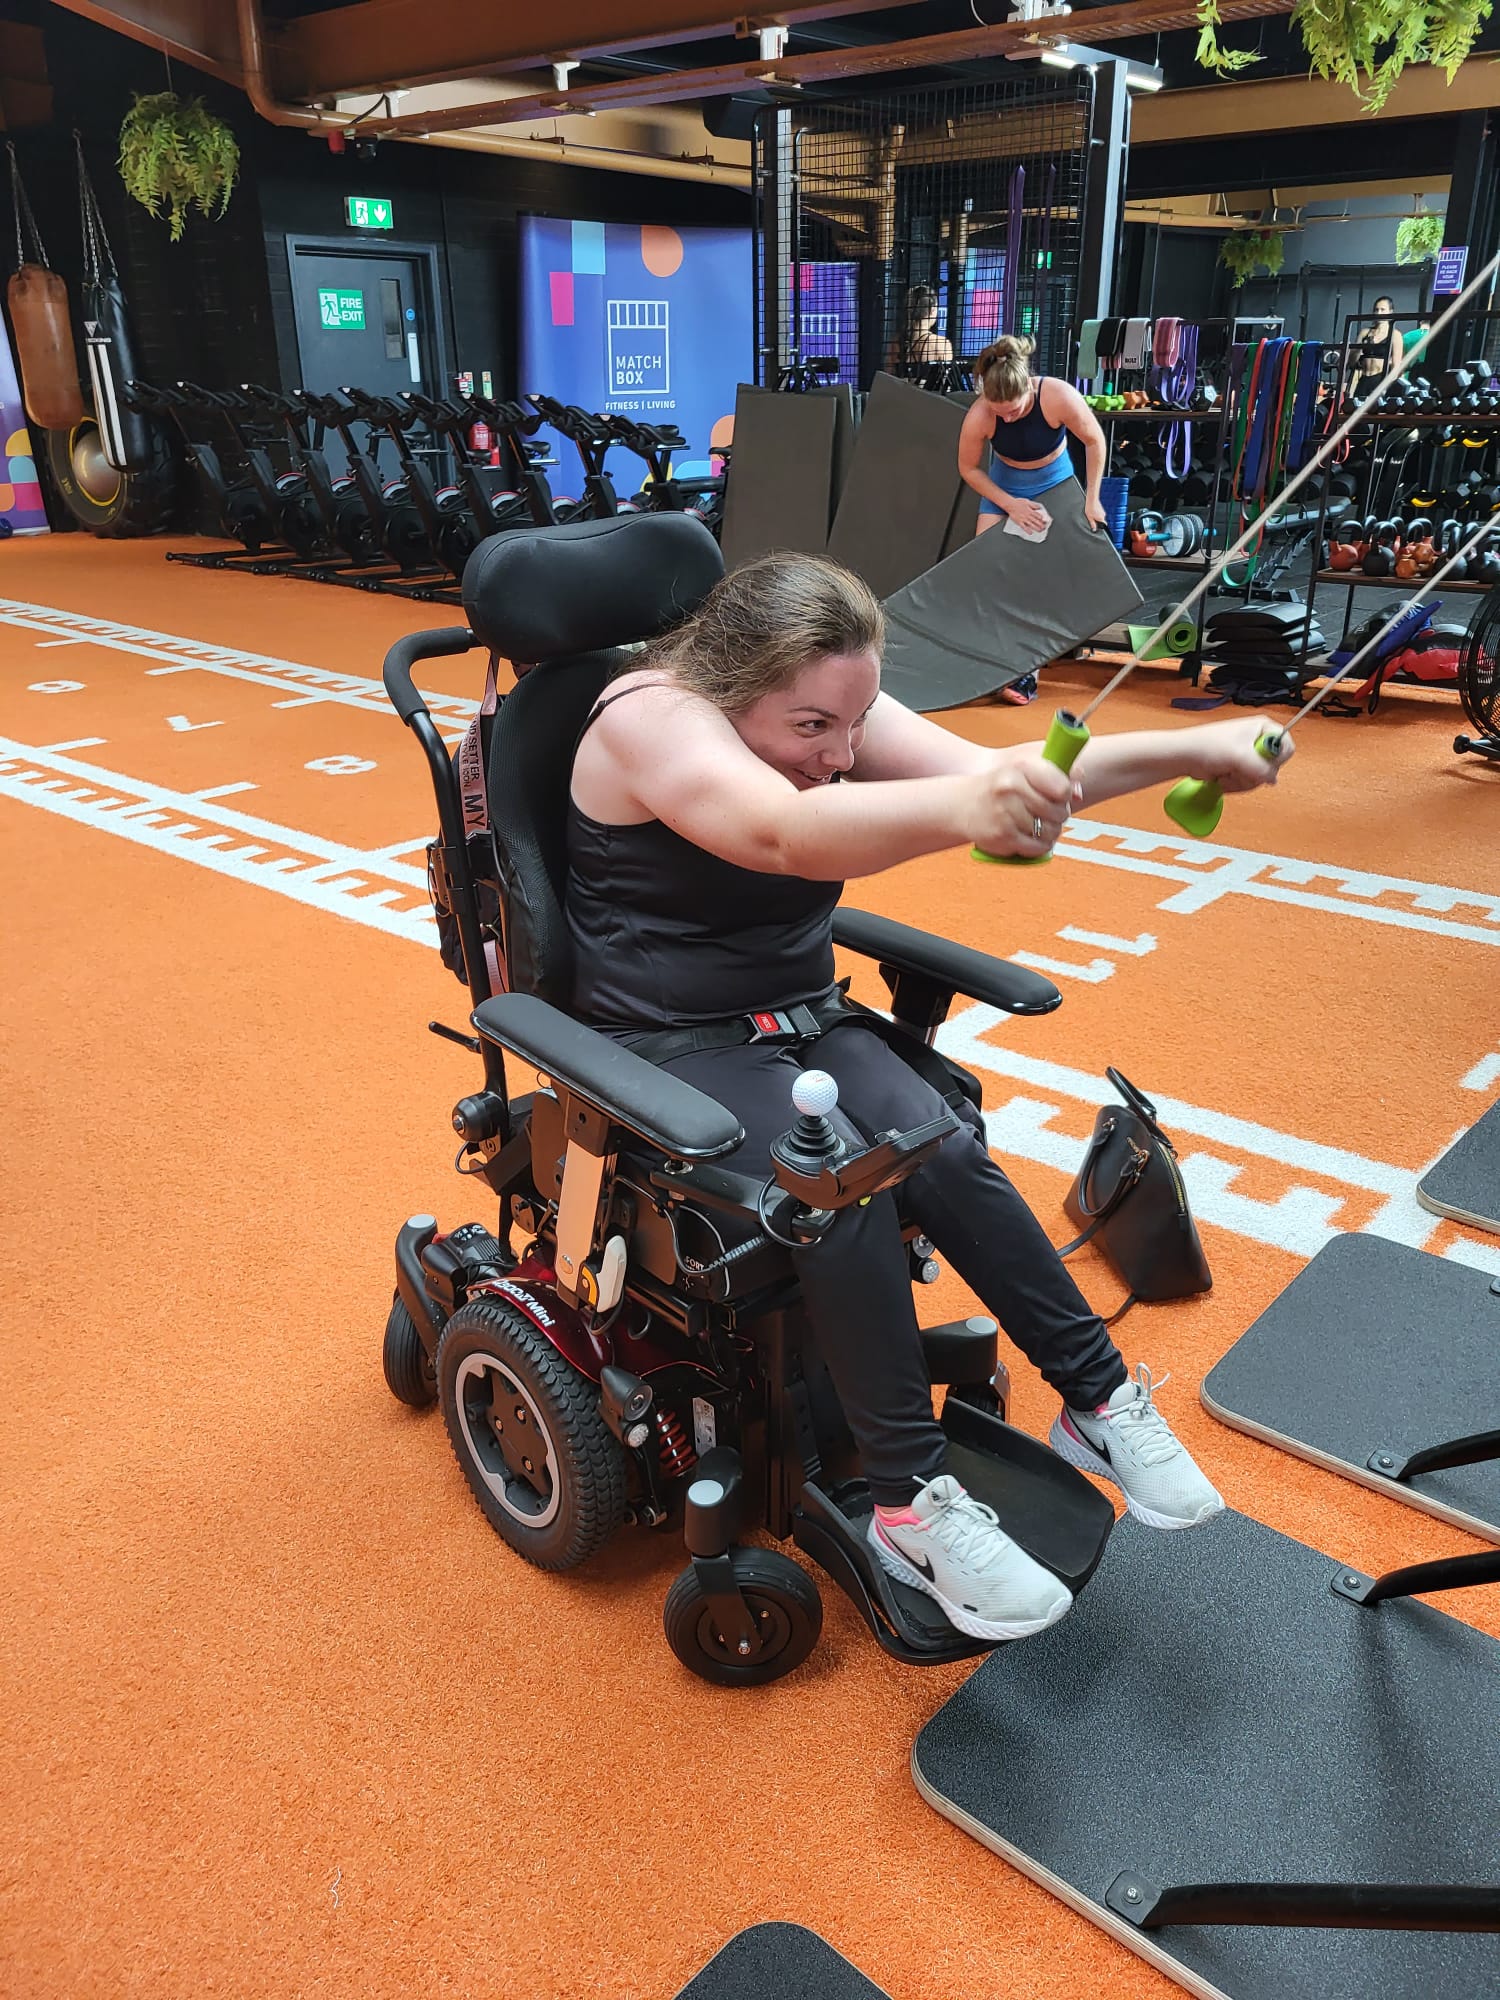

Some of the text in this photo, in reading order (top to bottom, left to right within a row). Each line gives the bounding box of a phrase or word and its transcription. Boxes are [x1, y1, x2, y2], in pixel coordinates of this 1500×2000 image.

[340, 297, 362, 309] FIRE
[341, 310, 363, 321] EXIT
[615, 355, 662, 370] MATCH
[615, 370, 644, 385] BOX
[605, 401, 639, 411] FITNESS
[646, 400, 676, 409] LIVING
[303, 753, 379, 776] 8
[468, 735, 480, 782] SETTER
[464, 793, 487, 827] MY
[526, 1301, 556, 1328] Mini
